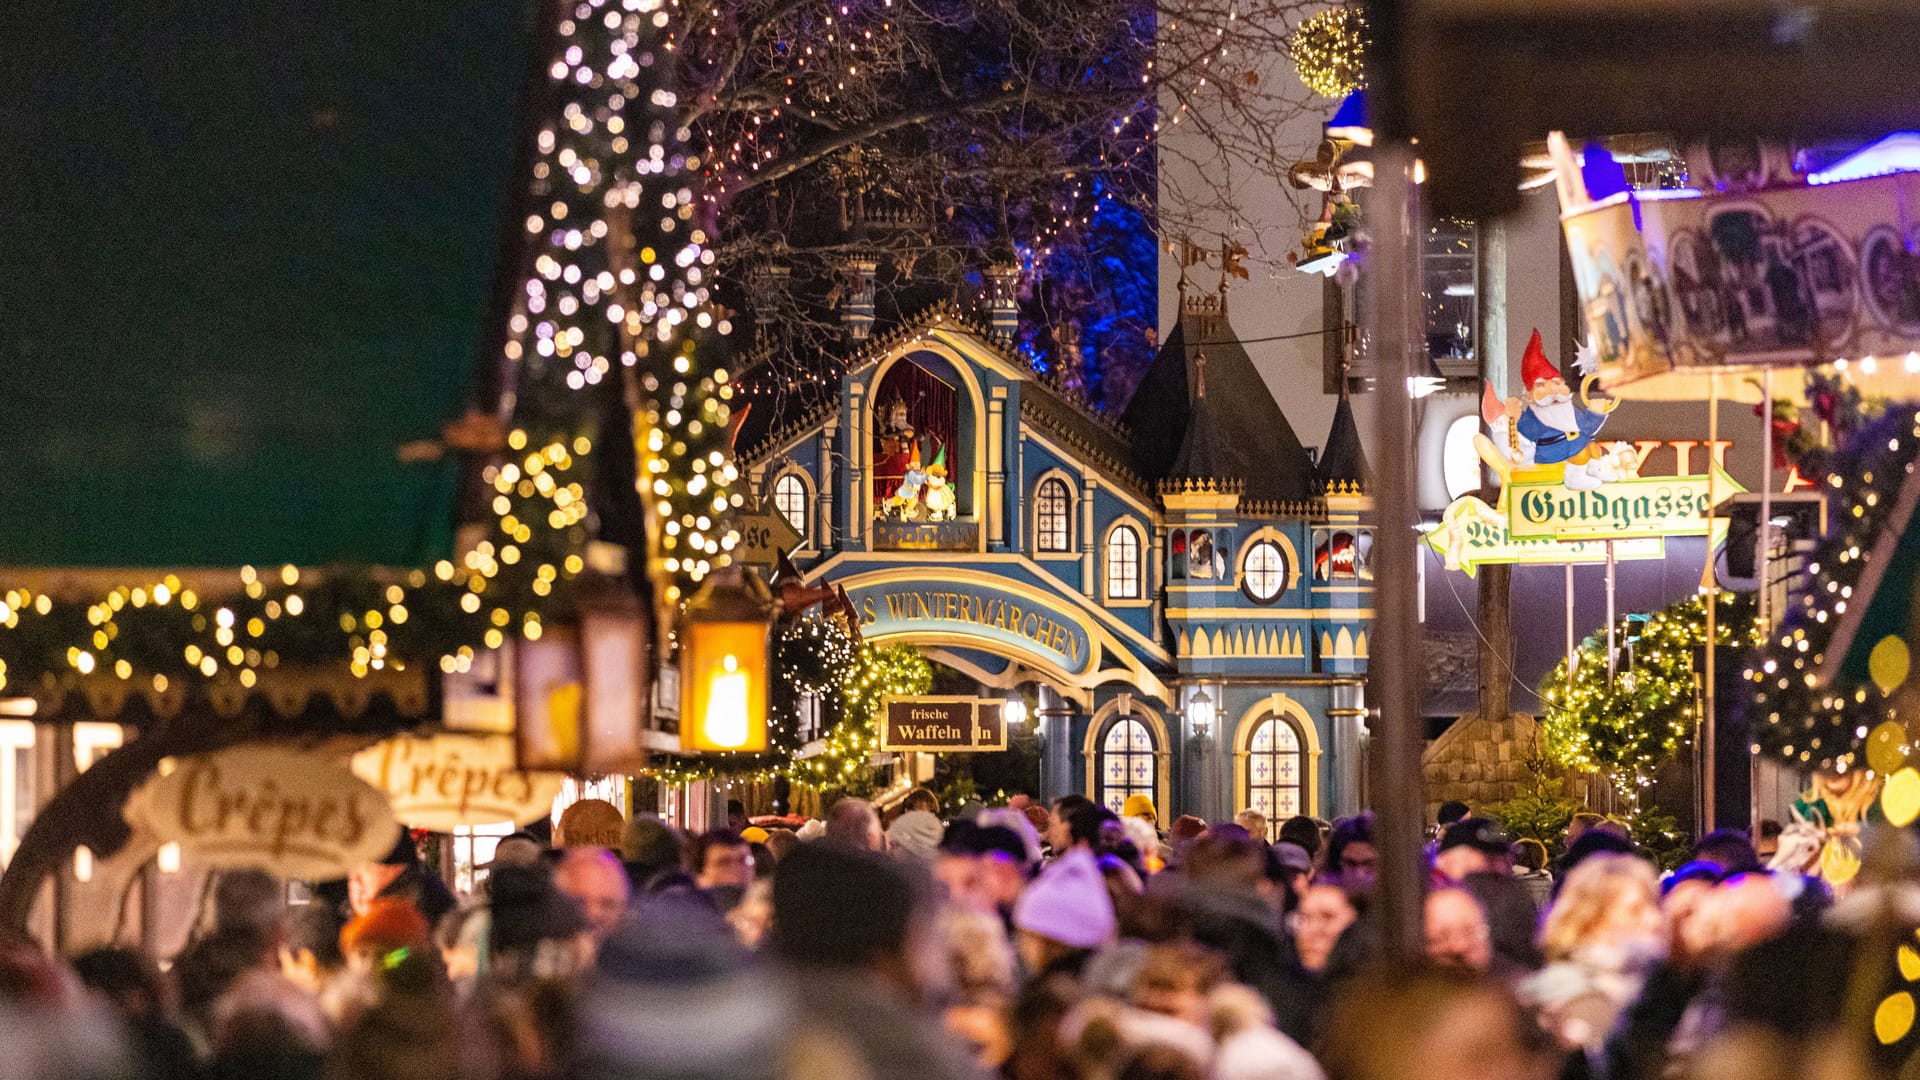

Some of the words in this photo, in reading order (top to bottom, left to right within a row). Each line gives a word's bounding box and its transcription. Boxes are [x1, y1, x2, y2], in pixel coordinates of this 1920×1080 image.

[1521, 487, 1710, 530] Goldgasse
[885, 591, 1083, 664] WINTERMÄRCHEN
[898, 725, 961, 740] Waffeln
[911, 709, 949, 720] frische
[380, 739, 532, 820] Crêpes
